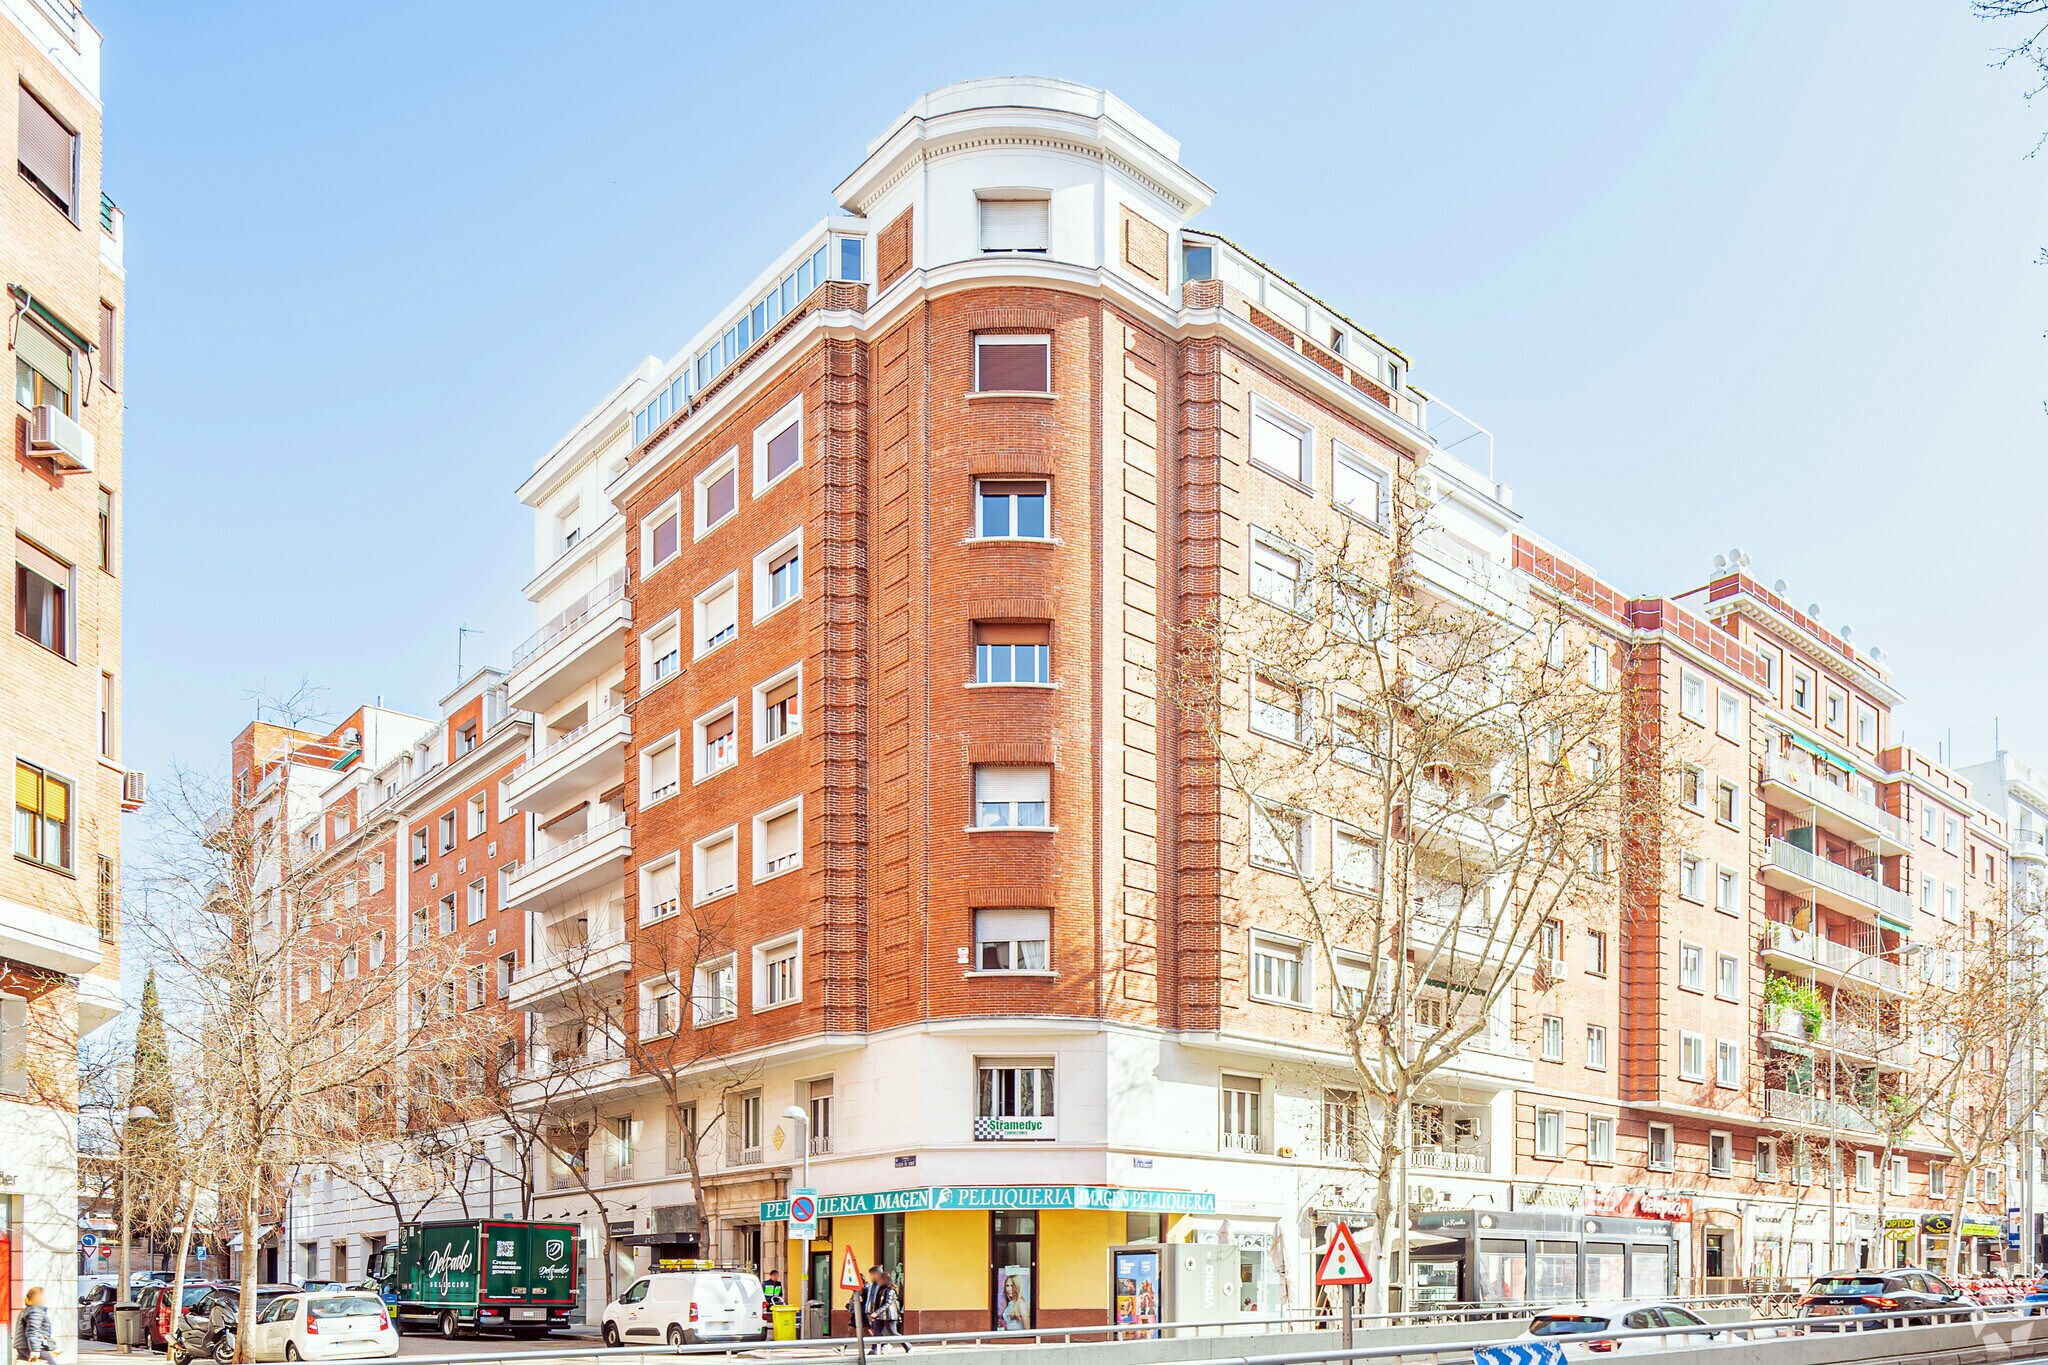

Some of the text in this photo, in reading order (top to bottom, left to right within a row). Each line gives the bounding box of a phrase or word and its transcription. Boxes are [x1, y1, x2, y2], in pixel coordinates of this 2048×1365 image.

[989, 1120, 1043, 1131] Stramedyc
[766, 1190, 930, 1219] PELUERIA IMAGEN
[958, 1188, 1073, 1208] PELUQUERIA
[1079, 1188, 1215, 1212] IMAGEN PELUQUERIA
[1886, 1220, 1915, 1228] OPTICA
[1205, 1264, 1215, 1309] VIDRIO
